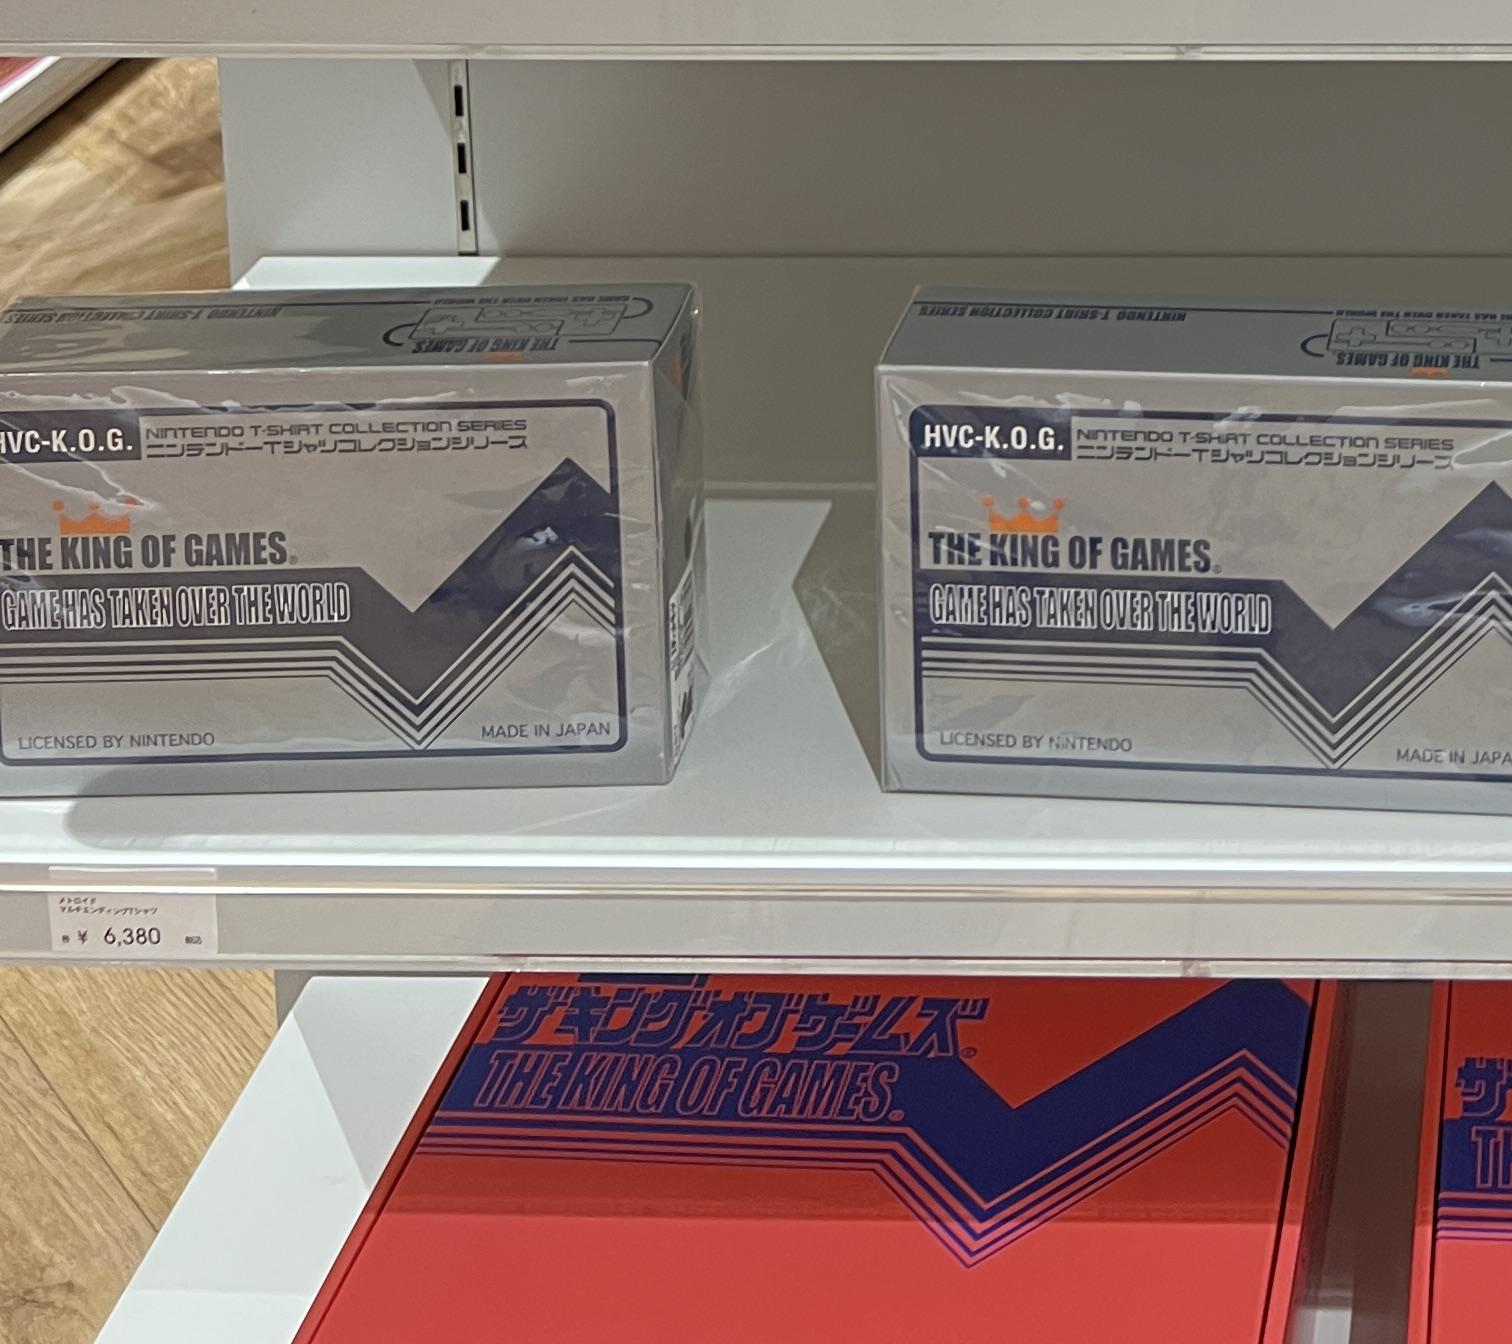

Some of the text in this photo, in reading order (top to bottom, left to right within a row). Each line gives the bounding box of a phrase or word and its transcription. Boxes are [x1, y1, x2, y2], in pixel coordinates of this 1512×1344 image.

[490, 338, 530, 352] KING
[529, 338, 560, 351] THE
[1391, 352, 1410, 367] OF
[1413, 353, 1450, 368] KING
[1452, 353, 1480, 369] THE
[146, 425, 244, 440] NINTENDO
[250, 423, 324, 437] T-SHIRT
[328, 420, 452, 434] COLLECTION
[457, 419, 527, 432] SERIES
[924, 424, 1454, 451] HVC-K.O.G. NINTENDO T-SHIRT COLLECTION SERIES
[0, 537, 53, 571] THE
[60, 534, 133, 570] KING
[141, 533, 176, 568] OF
[928, 532, 982, 566] THE
[990, 533, 1060, 569] KING
[1068, 535, 1104, 570] OF
[2, 582, 351, 631] GAME HAS TAKEN OVER THE WORLD
[930, 583, 1272, 635] GAME HAS TAKEN OVER THE WORLD
[481, 722, 611, 739] MADE IN JAPAN
[18, 732, 215, 750] LICENSED BY NINTENDO
[940, 732, 1132, 752] LICENSED BY NINTENDO
[1396, 748, 1444, 763] MADE
[1449, 750, 1465, 764] IN
[104, 927, 160, 947] 6,380
[478, 1050, 570, 1110] THE
[559, 1052, 682, 1114] KING
[676, 1056, 747, 1116] OF
